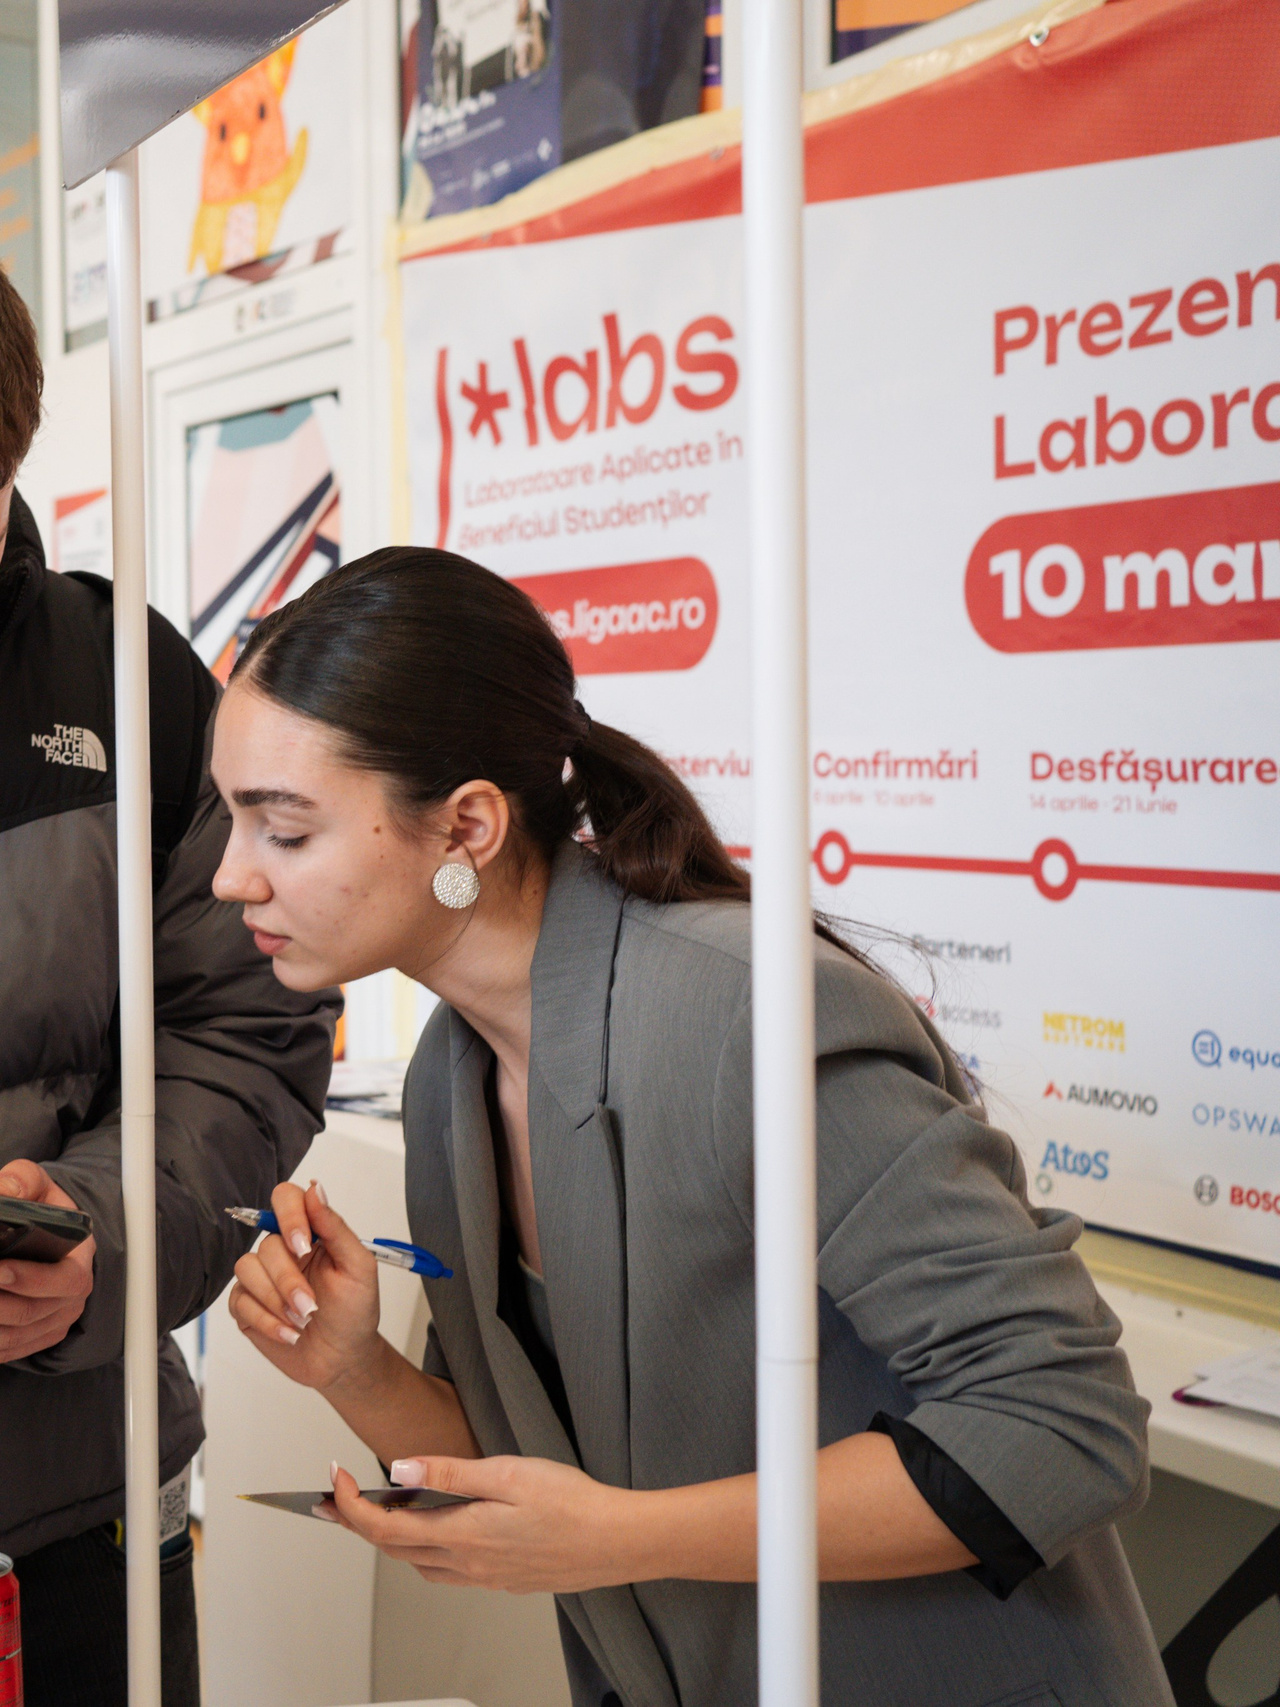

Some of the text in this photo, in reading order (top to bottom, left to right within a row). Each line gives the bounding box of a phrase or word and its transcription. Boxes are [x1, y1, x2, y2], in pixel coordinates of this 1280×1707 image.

[464, 462, 594, 508] Laboratoare
[600, 440, 711, 483] Aplicate
[458, 509, 560, 551] Beneficiul
[989, 543, 1085, 620] 10
[545, 596, 707, 645] s.ligaac.ro
[31, 733, 82, 753] NORTH
[53, 723, 83, 740] THE
[45, 748, 83, 767] FACE
[658, 749, 751, 777] nterviu
[813, 749, 978, 779] Confirmări
[1030, 749, 1279, 794] Desfășurare
[1049, 795, 1099, 812] aprilie
[1043, 1011, 1125, 1039] NETROM
[1068, 1084, 1158, 1116] AUMOVIO
